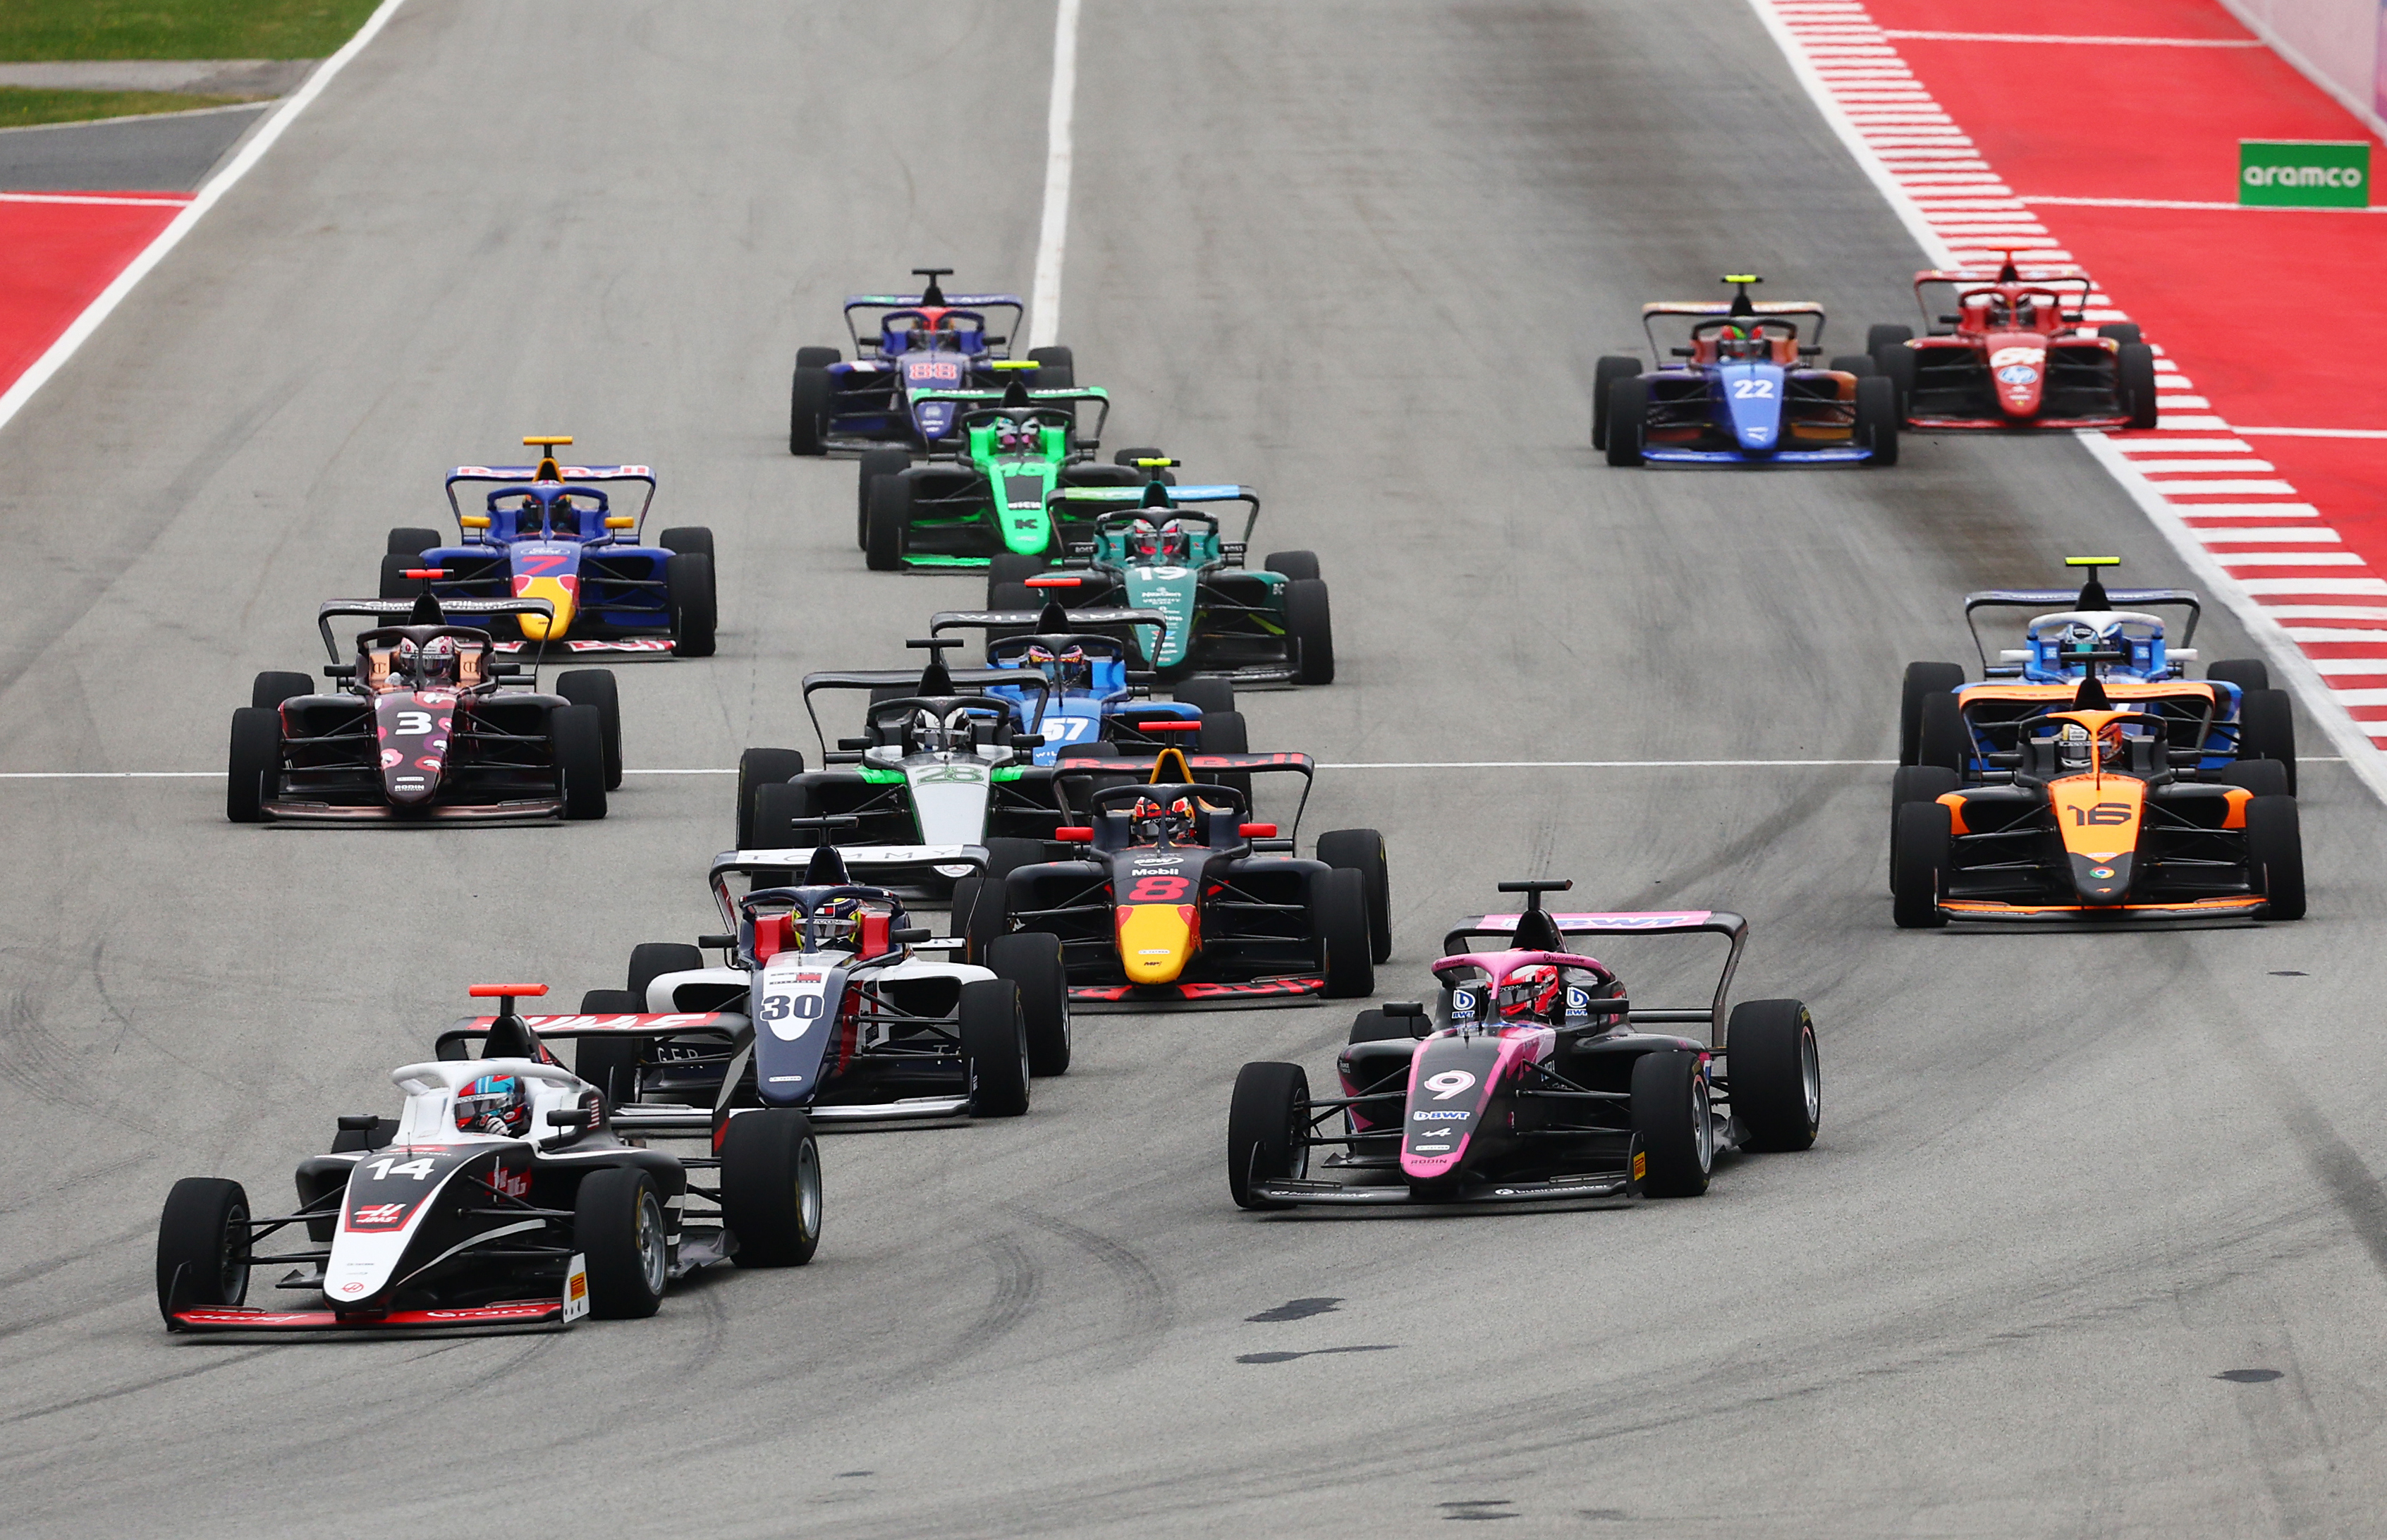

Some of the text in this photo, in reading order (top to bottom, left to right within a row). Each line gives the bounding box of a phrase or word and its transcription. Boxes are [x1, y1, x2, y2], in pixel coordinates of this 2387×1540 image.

[2243, 165, 2362, 188] aramco
[910, 362, 958, 380] 88
[1733, 379, 1774, 399] 22
[522, 555, 568, 575] 7
[1135, 566, 1188, 580] 19
[395, 711, 432, 735] 3
[1042, 718, 1089, 741] 57
[916, 766, 984, 784] 28
[2068, 802, 2131, 826] 16
[1129, 876, 1190, 901] 8
[761, 994, 824, 1020] 30
[1424, 1070, 1475, 1100] 9
[1430, 1111, 1470, 1120] BWT
[367, 1158, 435, 1180] 14
[1516, 1185, 1607, 1194] businessolver
[427, 1309, 537, 1318] Gram
